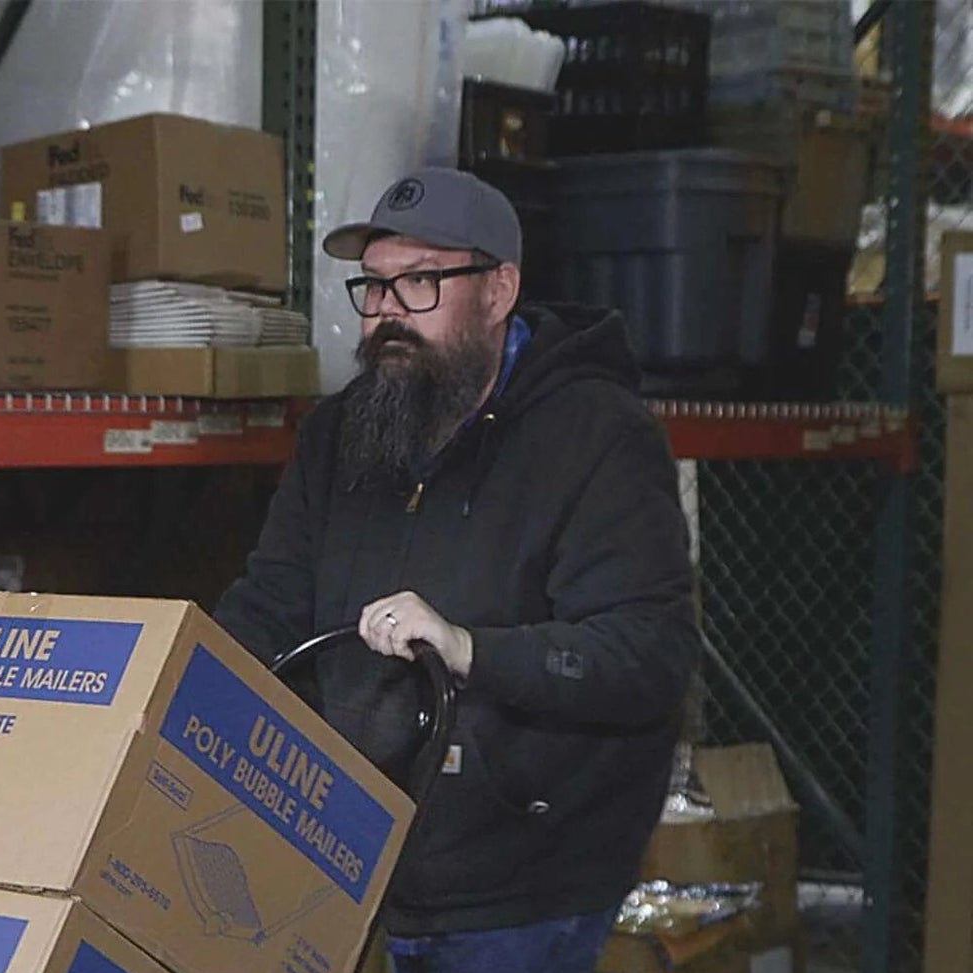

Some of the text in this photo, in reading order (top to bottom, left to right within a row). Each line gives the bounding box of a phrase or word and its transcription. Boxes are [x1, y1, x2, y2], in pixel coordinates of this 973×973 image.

[20, 668, 107, 693] MAILERS
[182, 715, 364, 883] POLY BUBBLE MAILERS
[249, 715, 334, 810] ULINE
